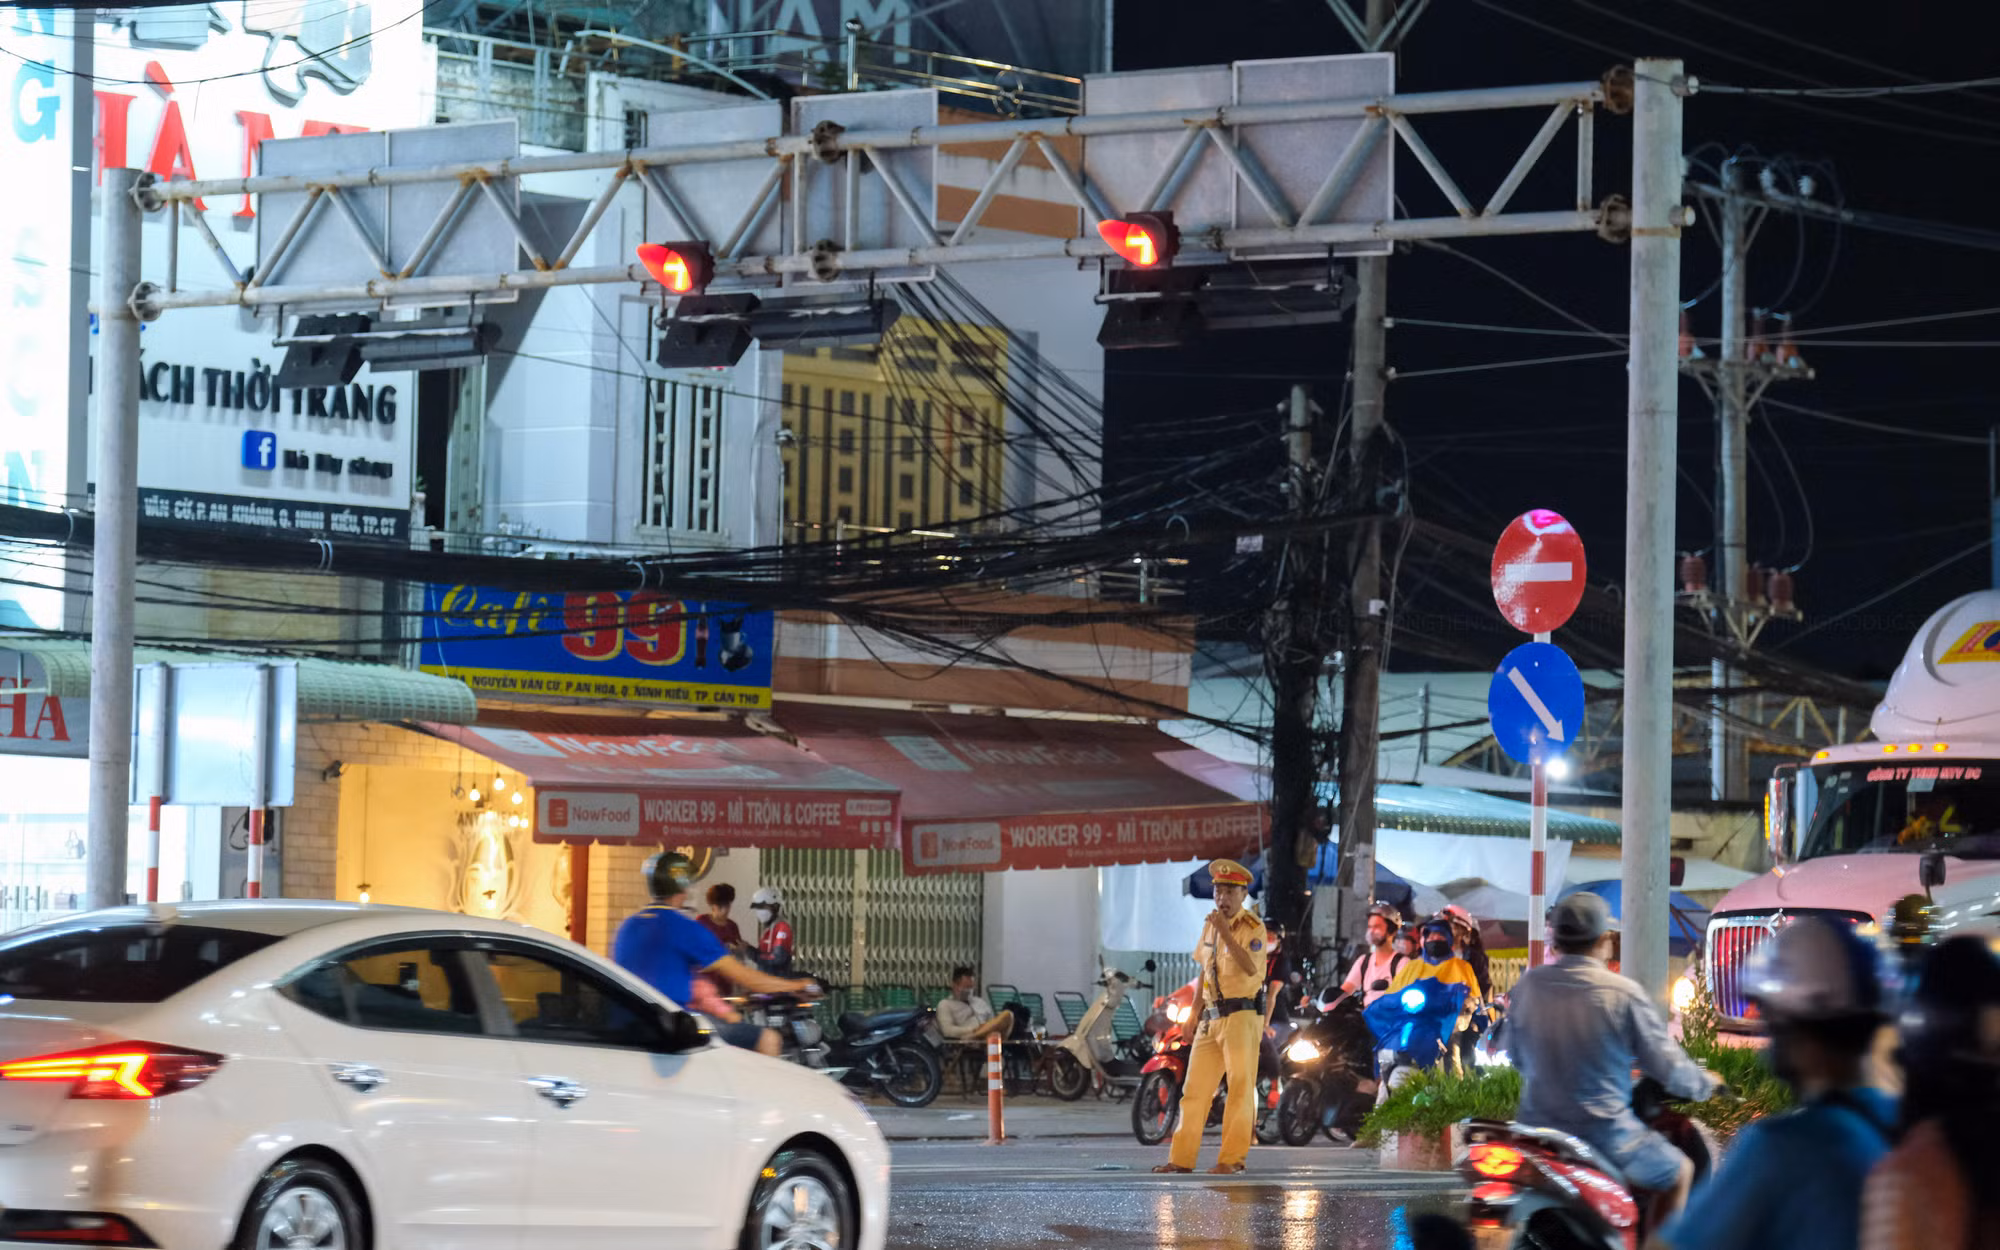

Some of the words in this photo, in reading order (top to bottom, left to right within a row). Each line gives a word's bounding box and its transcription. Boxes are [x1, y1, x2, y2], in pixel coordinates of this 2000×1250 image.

[562, 590, 688, 667] 99
[572, 806, 630, 823] NowFood
[644, 800, 698, 822] WORKER
[701, 801, 716, 823] 99
[728, 796, 743, 823] MÌ
[795, 803, 841, 826] COFFEE
[1009, 824, 1078, 848] WORKER
[1083, 823, 1101, 846] 99
[1117, 820, 1136, 843] MÌ
[1202, 815, 1260, 839] COFFEE
